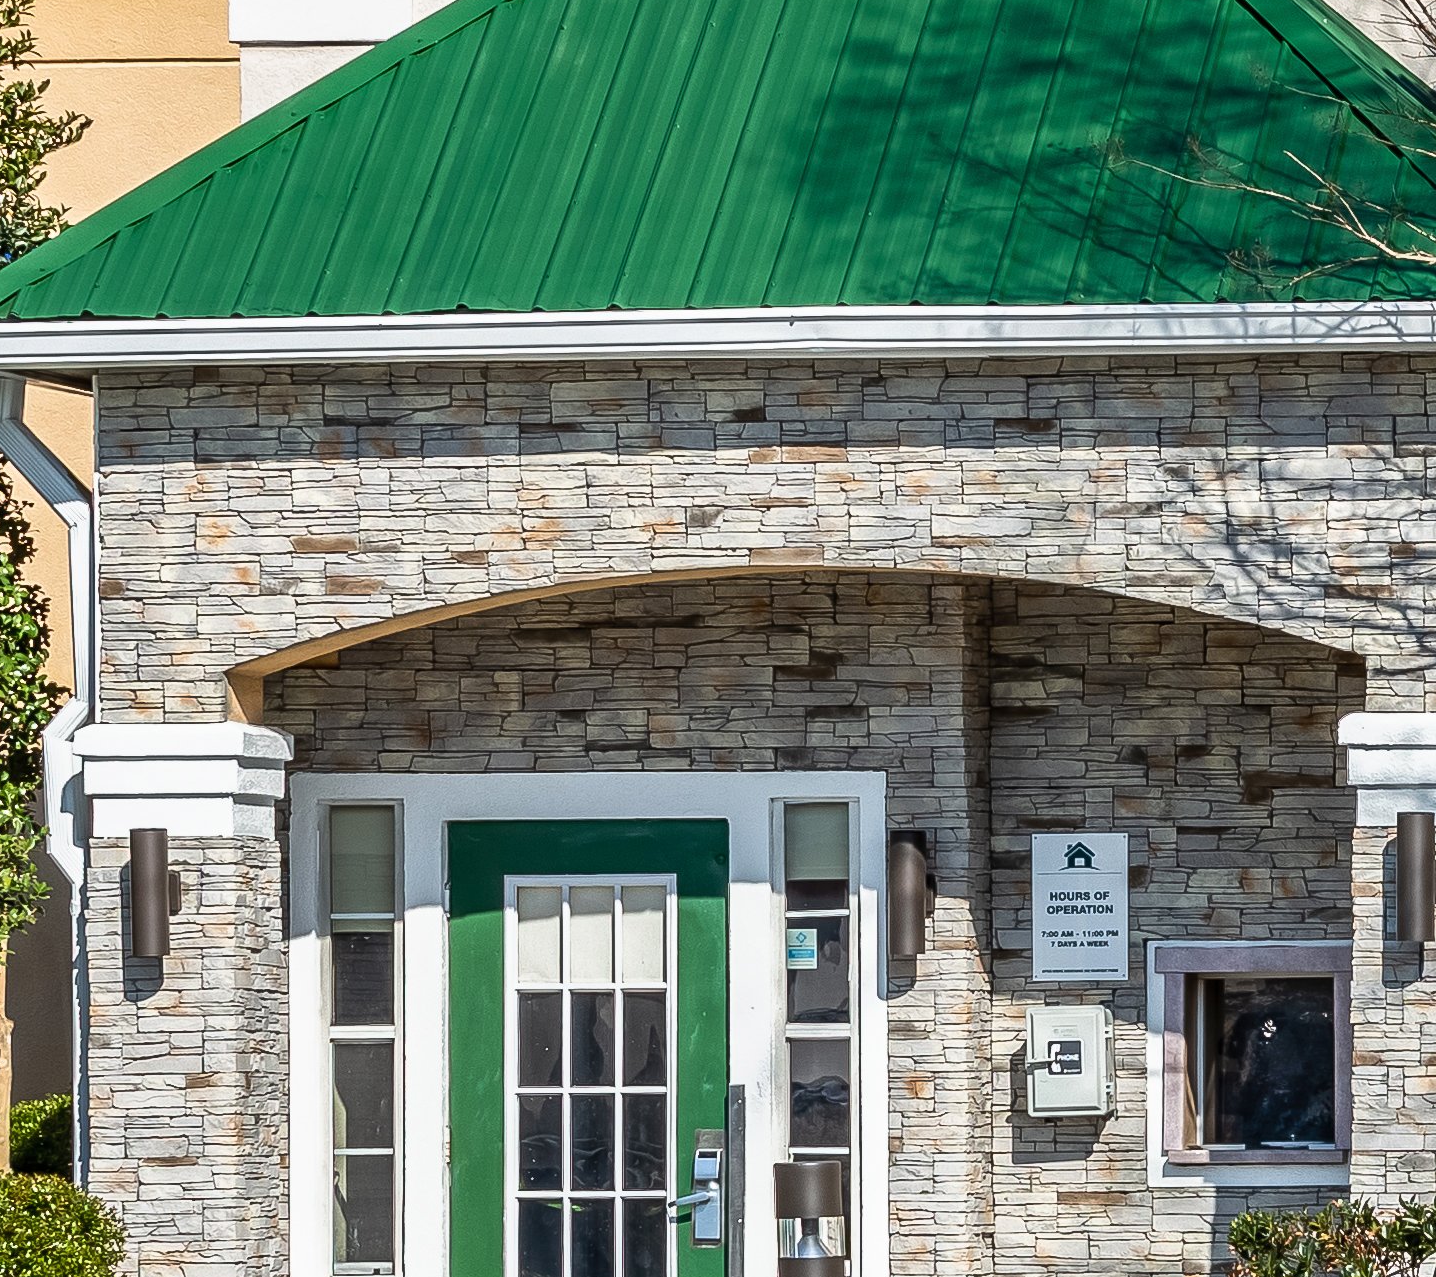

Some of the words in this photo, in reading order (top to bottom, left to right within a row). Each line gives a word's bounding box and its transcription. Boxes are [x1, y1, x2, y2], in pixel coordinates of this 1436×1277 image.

[1049, 891, 1091, 902] HOURS
[1093, 891, 1110, 901] OF
[1046, 904, 1114, 915] OPERATION
[1041, 930, 1059, 938] 7:00
[1060, 930, 1074, 938] AM
[1082, 930, 1105, 938] 11:00
